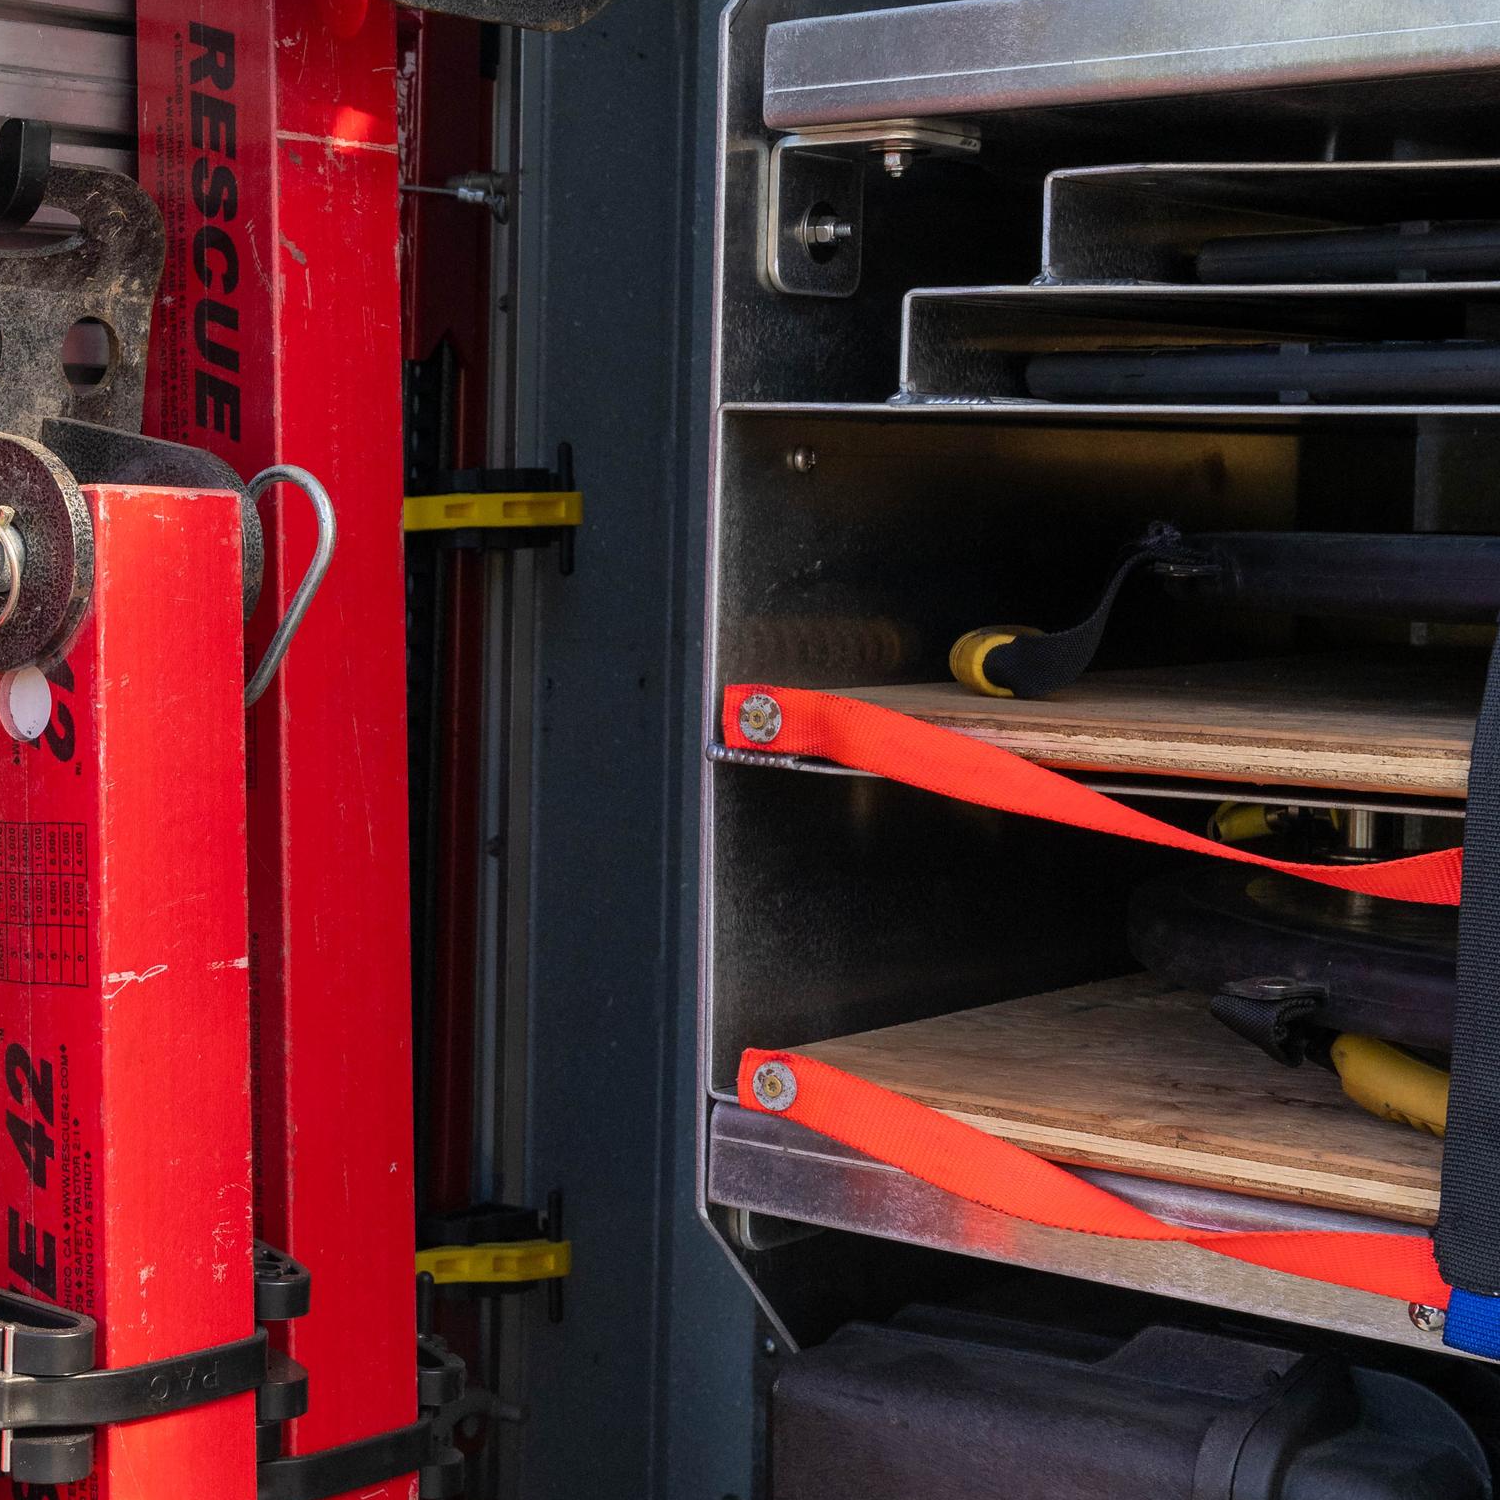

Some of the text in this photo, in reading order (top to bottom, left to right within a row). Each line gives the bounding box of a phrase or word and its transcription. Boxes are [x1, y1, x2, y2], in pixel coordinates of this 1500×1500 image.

[190, 21, 241, 442] RESCUE
[73, 1155, 81, 1214] FACTOR
[83, 1160, 93, 1210] STRUT
[63, 1237, 72, 1258] CA
[74, 1217, 83, 1277] SAFETY
[84, 1226, 94, 1249] OF
[86, 1253, 95, 1308] RATING
[148, 1360, 220, 1400] PAC
